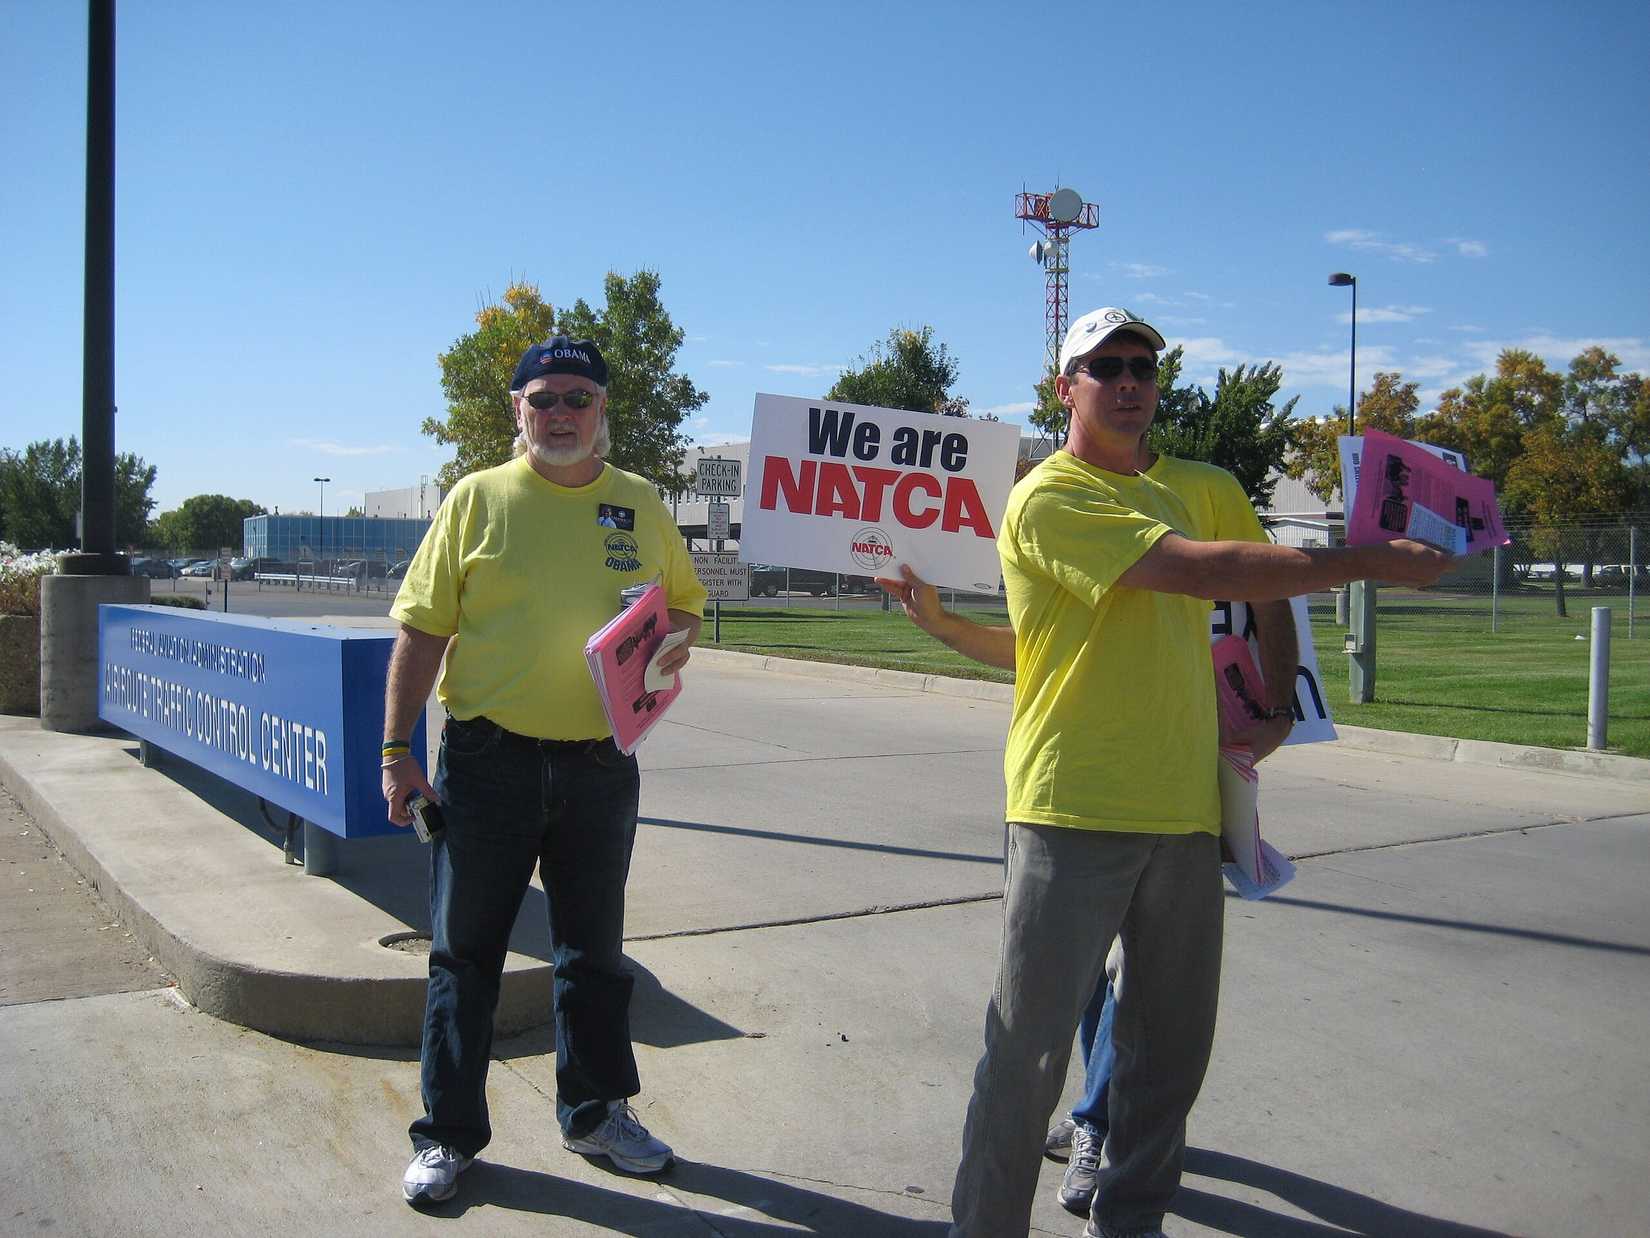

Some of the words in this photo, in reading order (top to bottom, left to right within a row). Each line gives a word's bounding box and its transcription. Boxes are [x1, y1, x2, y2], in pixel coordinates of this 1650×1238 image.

[554, 349, 591, 364] OBAMA
[808, 407, 880, 461] We
[891, 426, 969, 472] are
[699, 463, 740, 477] CHECK-IN
[701, 479, 737, 492] PARKING
[760, 455, 996, 539] NATCA
[851, 542, 893, 558] NATCA
[605, 557, 643, 572] OBAMA
[694, 556, 709, 565] NON
[714, 556, 738, 565] FACILIT
[730, 567, 747, 576] MUST
[727, 578, 742, 587] WITH
[130, 627, 157, 657] FEDERAL
[158, 634, 190, 665] AVIATION
[192, 639, 266, 684] ADMINISTRATION
[105, 663, 119, 705] AIR
[120, 666, 149, 718] ROUTE
[150, 676, 193, 737] TRAFFIC
[196, 689, 257, 765] CONTROL
[261, 711, 328, 797] CENTER
